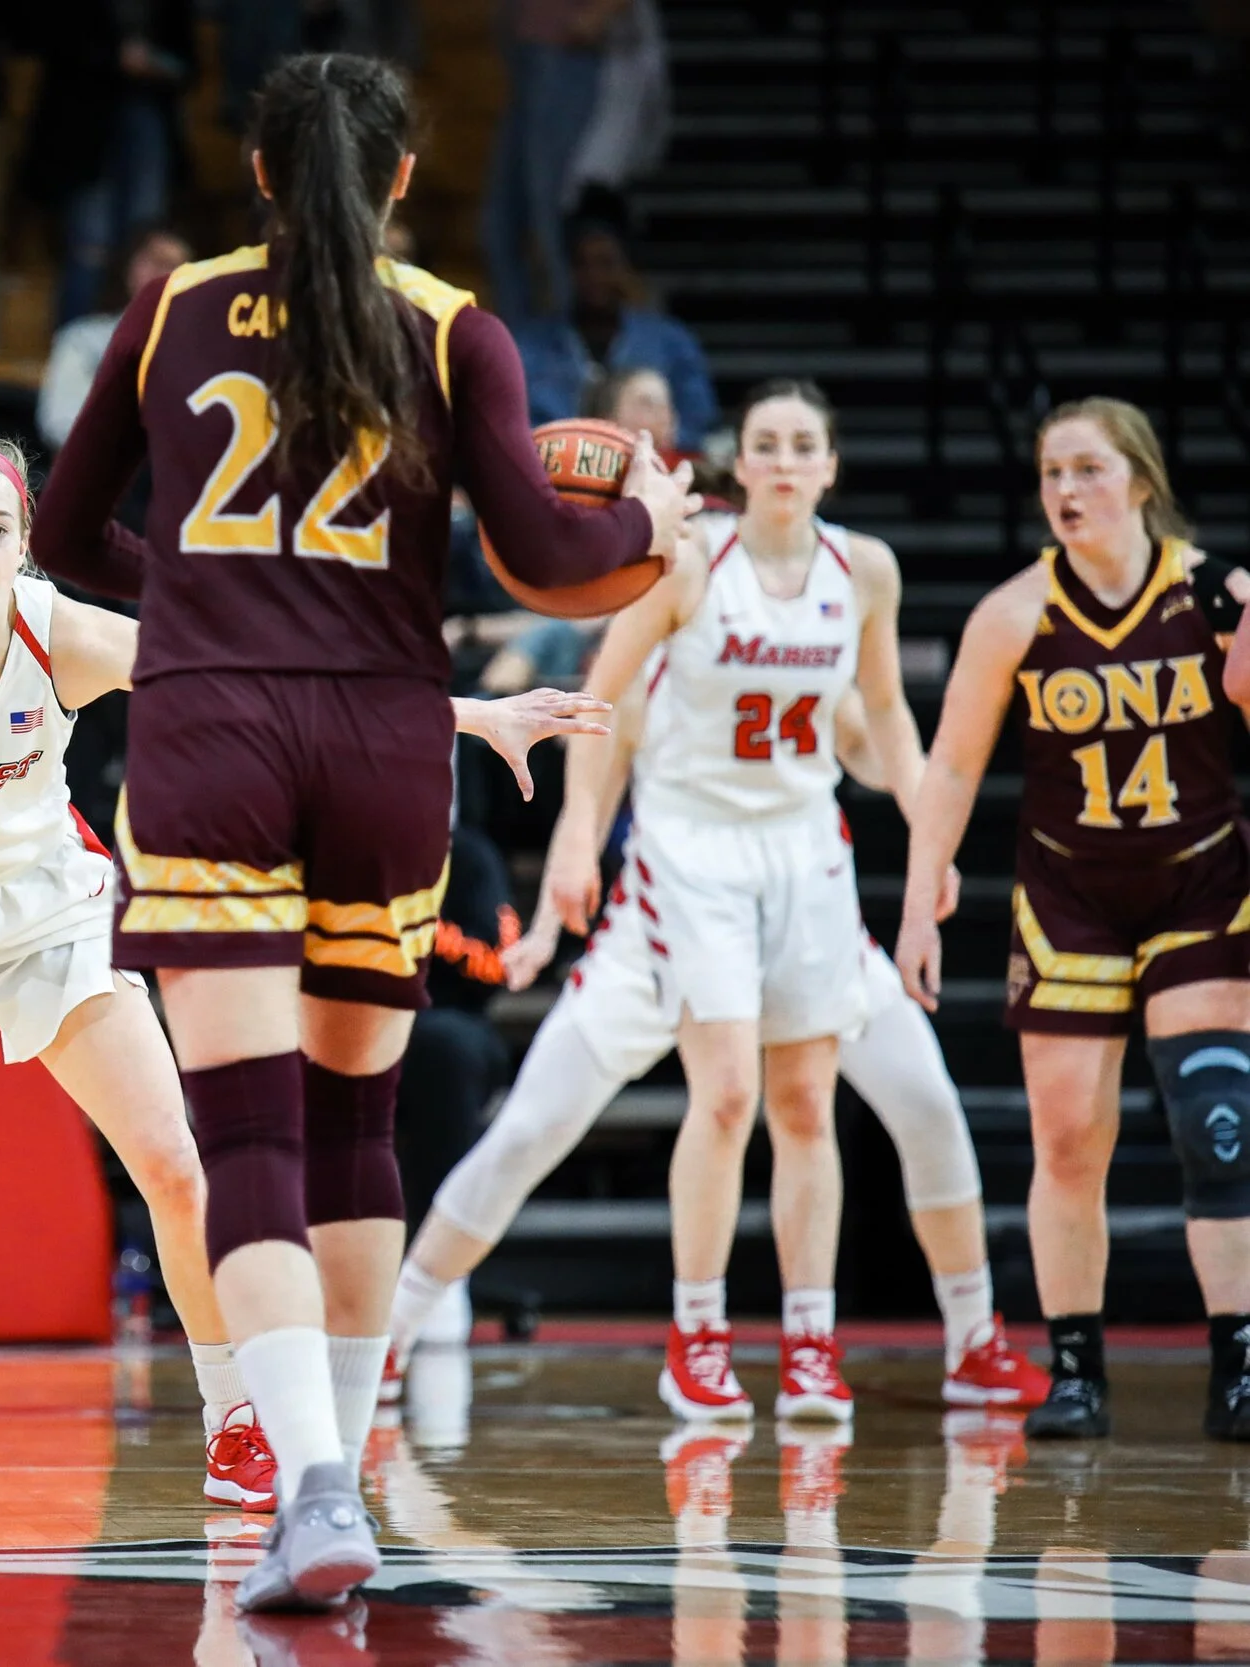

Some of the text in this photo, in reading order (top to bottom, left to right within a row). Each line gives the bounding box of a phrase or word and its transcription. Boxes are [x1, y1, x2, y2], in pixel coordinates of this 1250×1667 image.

[228, 292, 288, 339] CA
[179, 370, 391, 569] 22
[716, 632, 843, 668] MARIST
[733, 691, 822, 760] 24
[1017, 653, 1214, 735] IONA
[1071, 733, 1181, 829] 14
